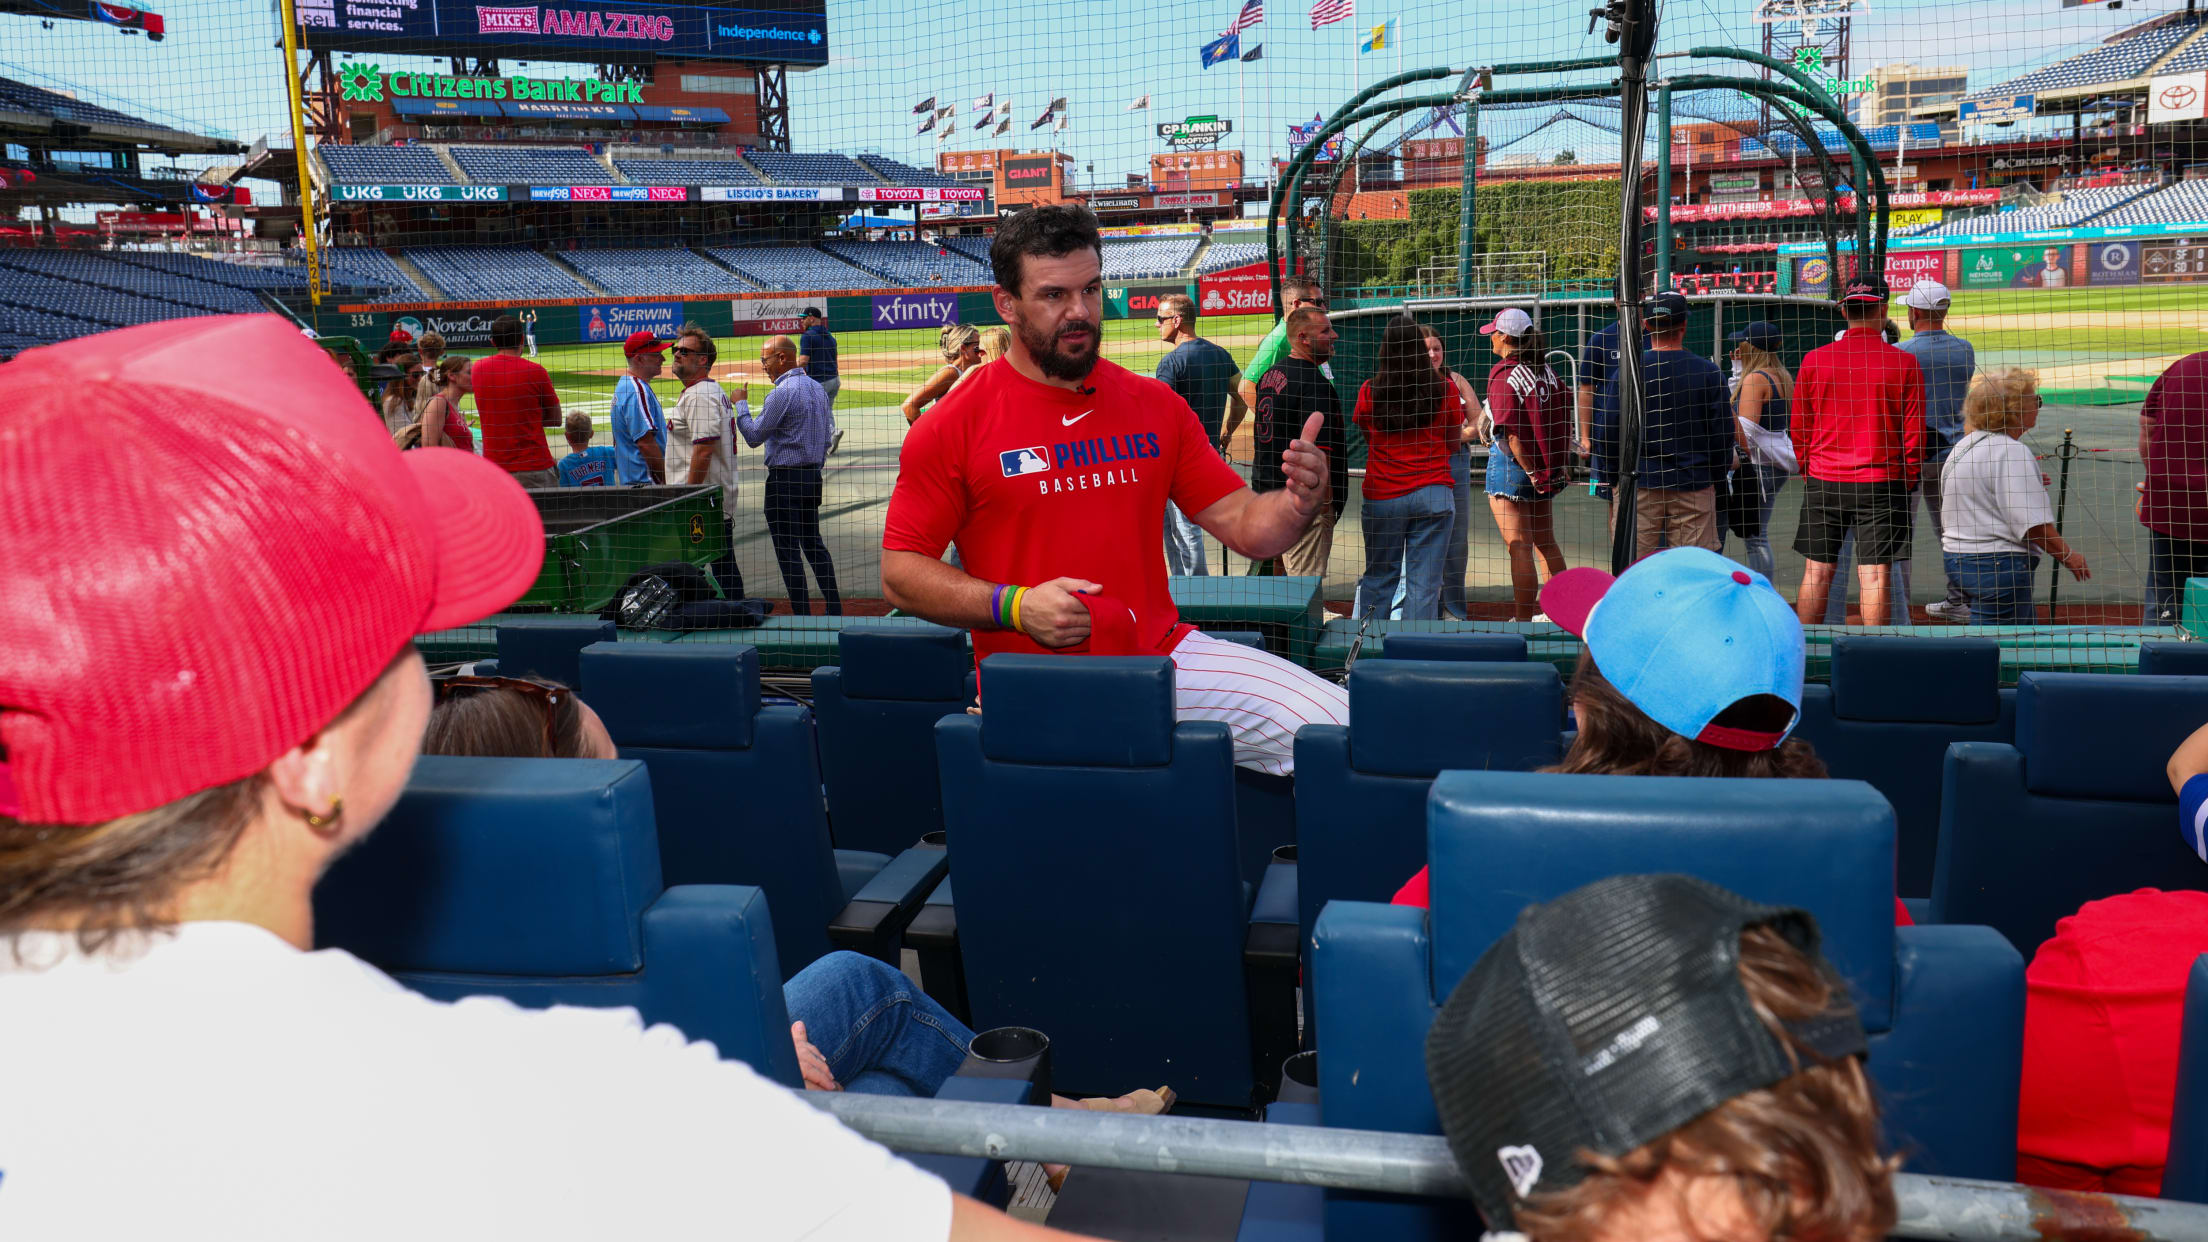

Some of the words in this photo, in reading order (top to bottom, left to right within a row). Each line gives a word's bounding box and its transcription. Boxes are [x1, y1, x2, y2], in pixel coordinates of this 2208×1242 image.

[346, 4, 402, 18] financial
[347, 19, 404, 32] services.
[485, 13, 532, 27] MIKE'S
[543, 9, 674, 41] AMAZING
[718, 24, 806, 40] Independence
[389, 71, 507, 100] Citizens
[511, 75, 582, 102] Bank
[585, 78, 645, 104] Park
[1826, 74, 1876, 94] Bank
[1162, 124, 1180, 134] CP
[1174, 136, 1215, 145] ROOFTOP
[1008, 167, 1048, 179] GIANT
[342, 186, 383, 199] UKG
[403, 186, 442, 199] UKG
[461, 186, 499, 199] UKG
[573, 188, 608, 199] NECA
[651, 188, 686, 200] NECA
[727, 189, 773, 199] LISCIO'S
[776, 189, 819, 199] BAKERY
[880, 189, 920, 199] TOYOTA
[943, 189, 983, 199] TOYOTA
[1895, 213, 1923, 223] PLAY
[1885, 255, 1940, 274] Temple
[962, 285, 993, 293] ASPLUN
[1107, 289, 1123, 299] 387
[1129, 296, 1159, 310] GIA
[1227, 288, 1273, 308] State
[608, 307, 672, 322] SHERWIN
[752, 302, 805, 318] Yuenglin
[878, 297, 953, 324] xfinity
[351, 314, 373, 327] 334
[426, 316, 494, 333] NovaCar
[762, 319, 800, 331] LAGER
[1256, 395, 1274, 444] 3
[1054, 432, 1160, 469] PHILLIES
[1040, 468, 1138, 495] BASEBALL
